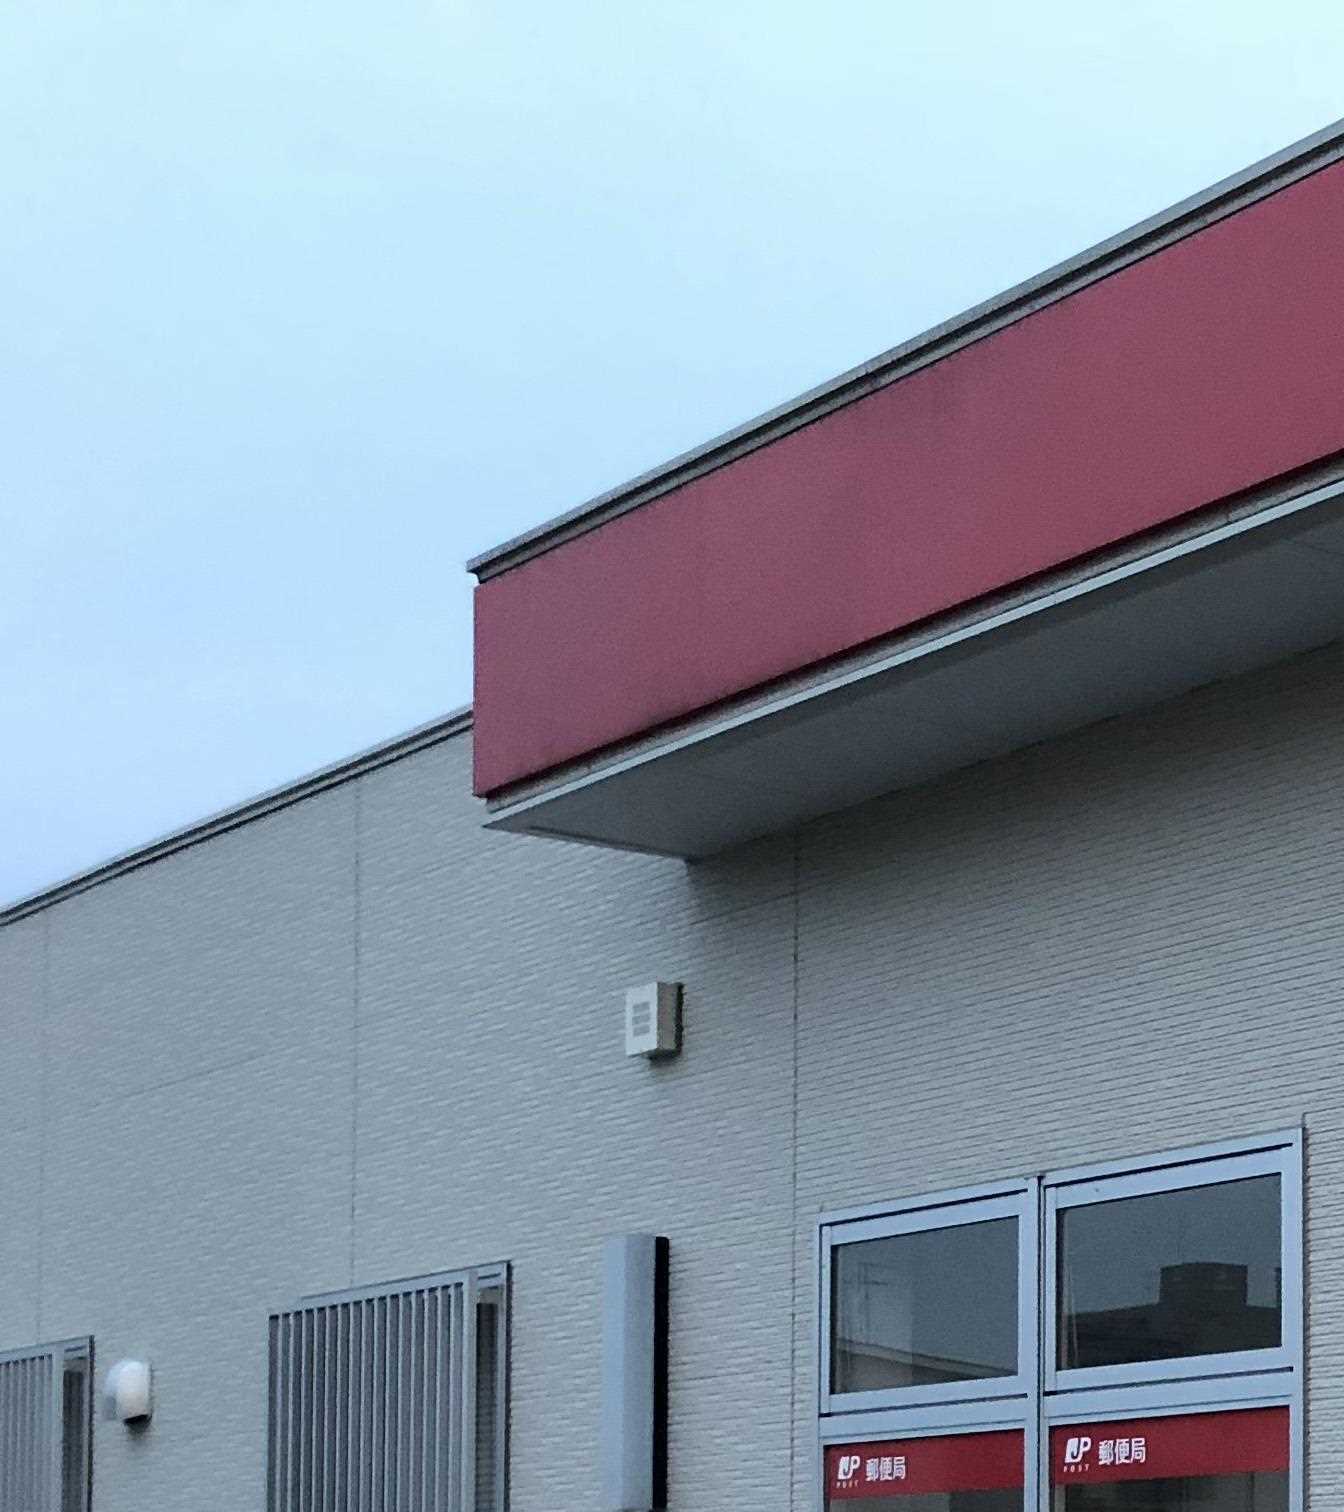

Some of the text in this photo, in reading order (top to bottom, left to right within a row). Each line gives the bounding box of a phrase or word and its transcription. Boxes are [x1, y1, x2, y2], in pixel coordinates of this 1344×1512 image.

[1098, 1438, 1146, 1466] 郵便局
[865, 1455, 906, 1482] 郵便局
